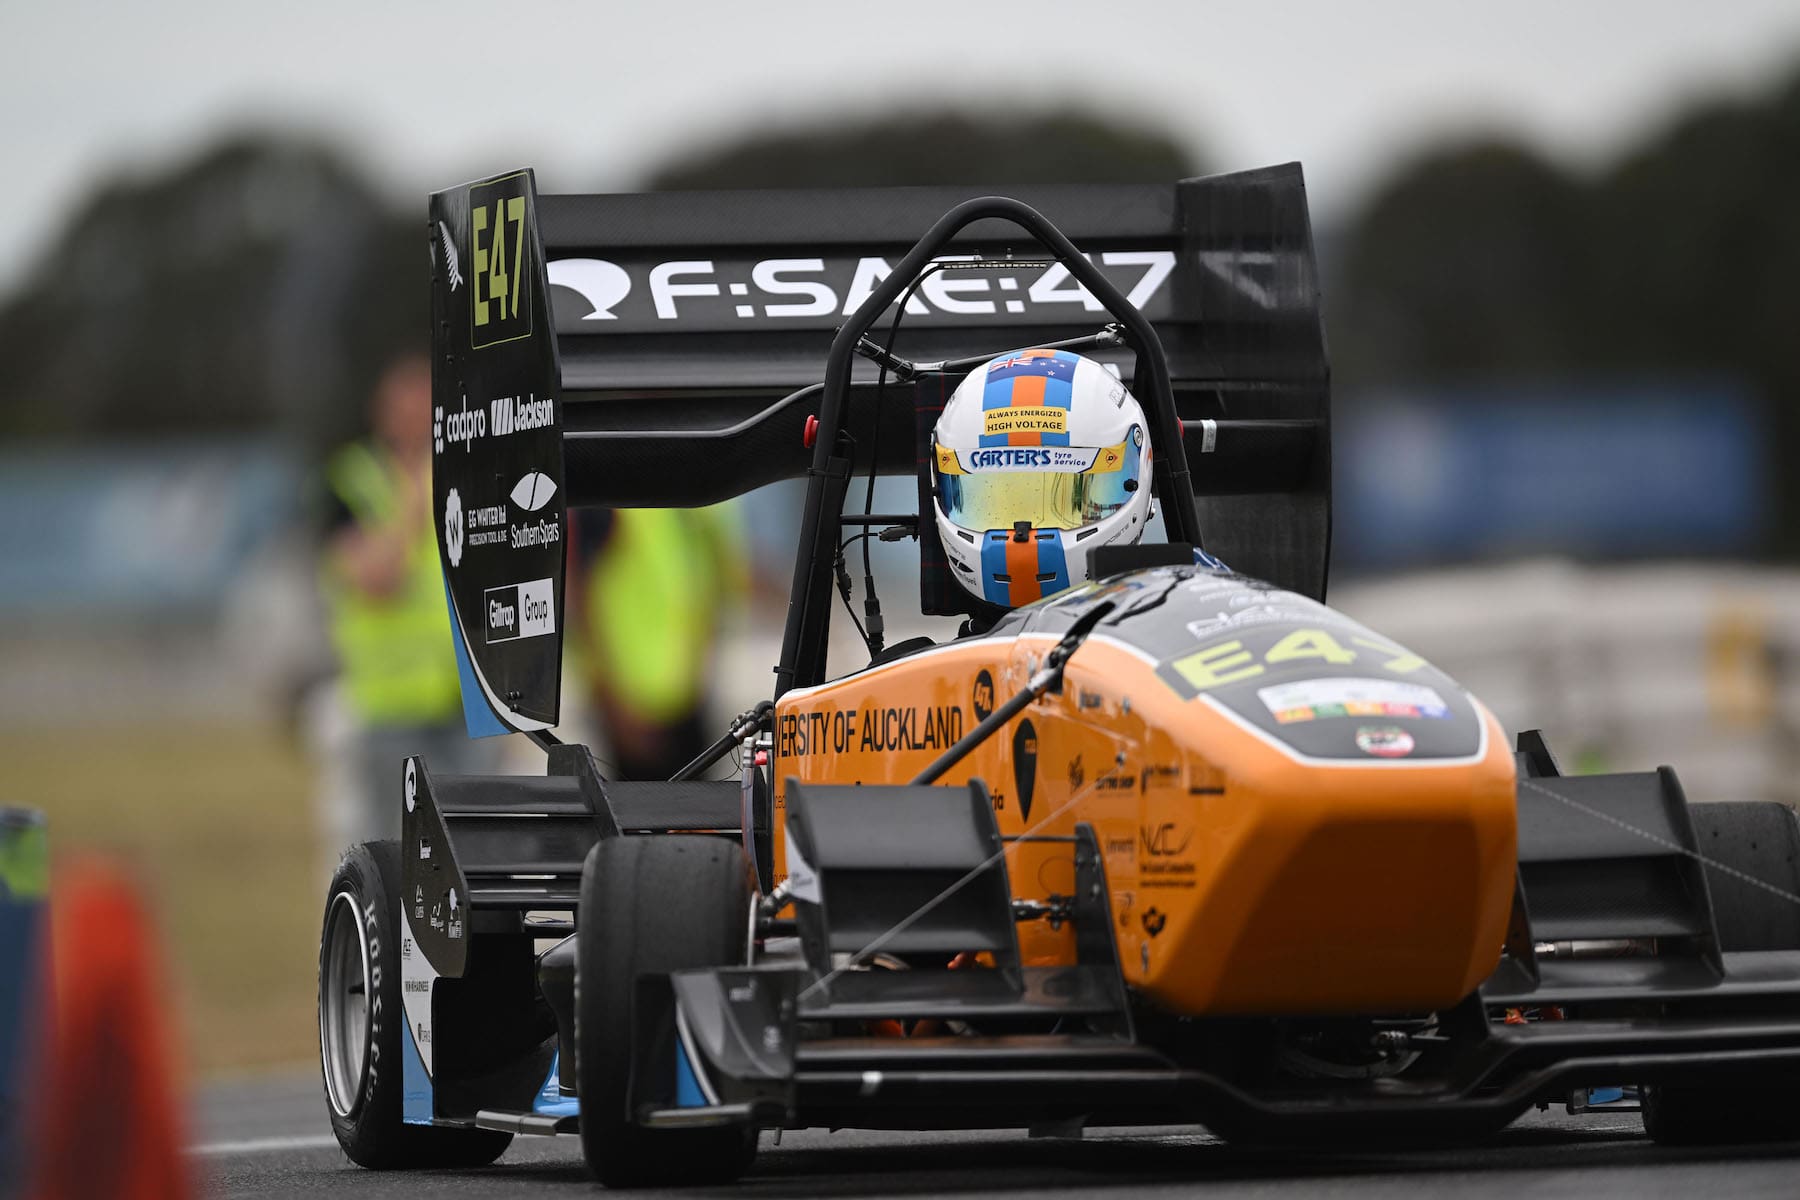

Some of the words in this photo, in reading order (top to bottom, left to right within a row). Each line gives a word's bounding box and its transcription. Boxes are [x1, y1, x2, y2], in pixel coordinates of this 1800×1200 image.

[472, 196, 525, 326] E47
[446, 394, 486, 453] cadpro
[514, 393, 554, 432] Jackson
[987, 421, 1013, 432] HIGH
[1016, 420, 1063, 430] VOLTAGE
[988, 410, 1019, 419] ALWAYS
[1020, 409, 1063, 418] ENERGIZED
[970, 449, 1052, 468] CARTER'S
[1054, 459, 1087, 467] service
[525, 593, 547, 628] Group
[1172, 629, 1428, 689] E47
[775, 711, 830, 758] VERSITY
[833, 710, 857, 754] OF
[860, 705, 962, 753] AUCKLAND
